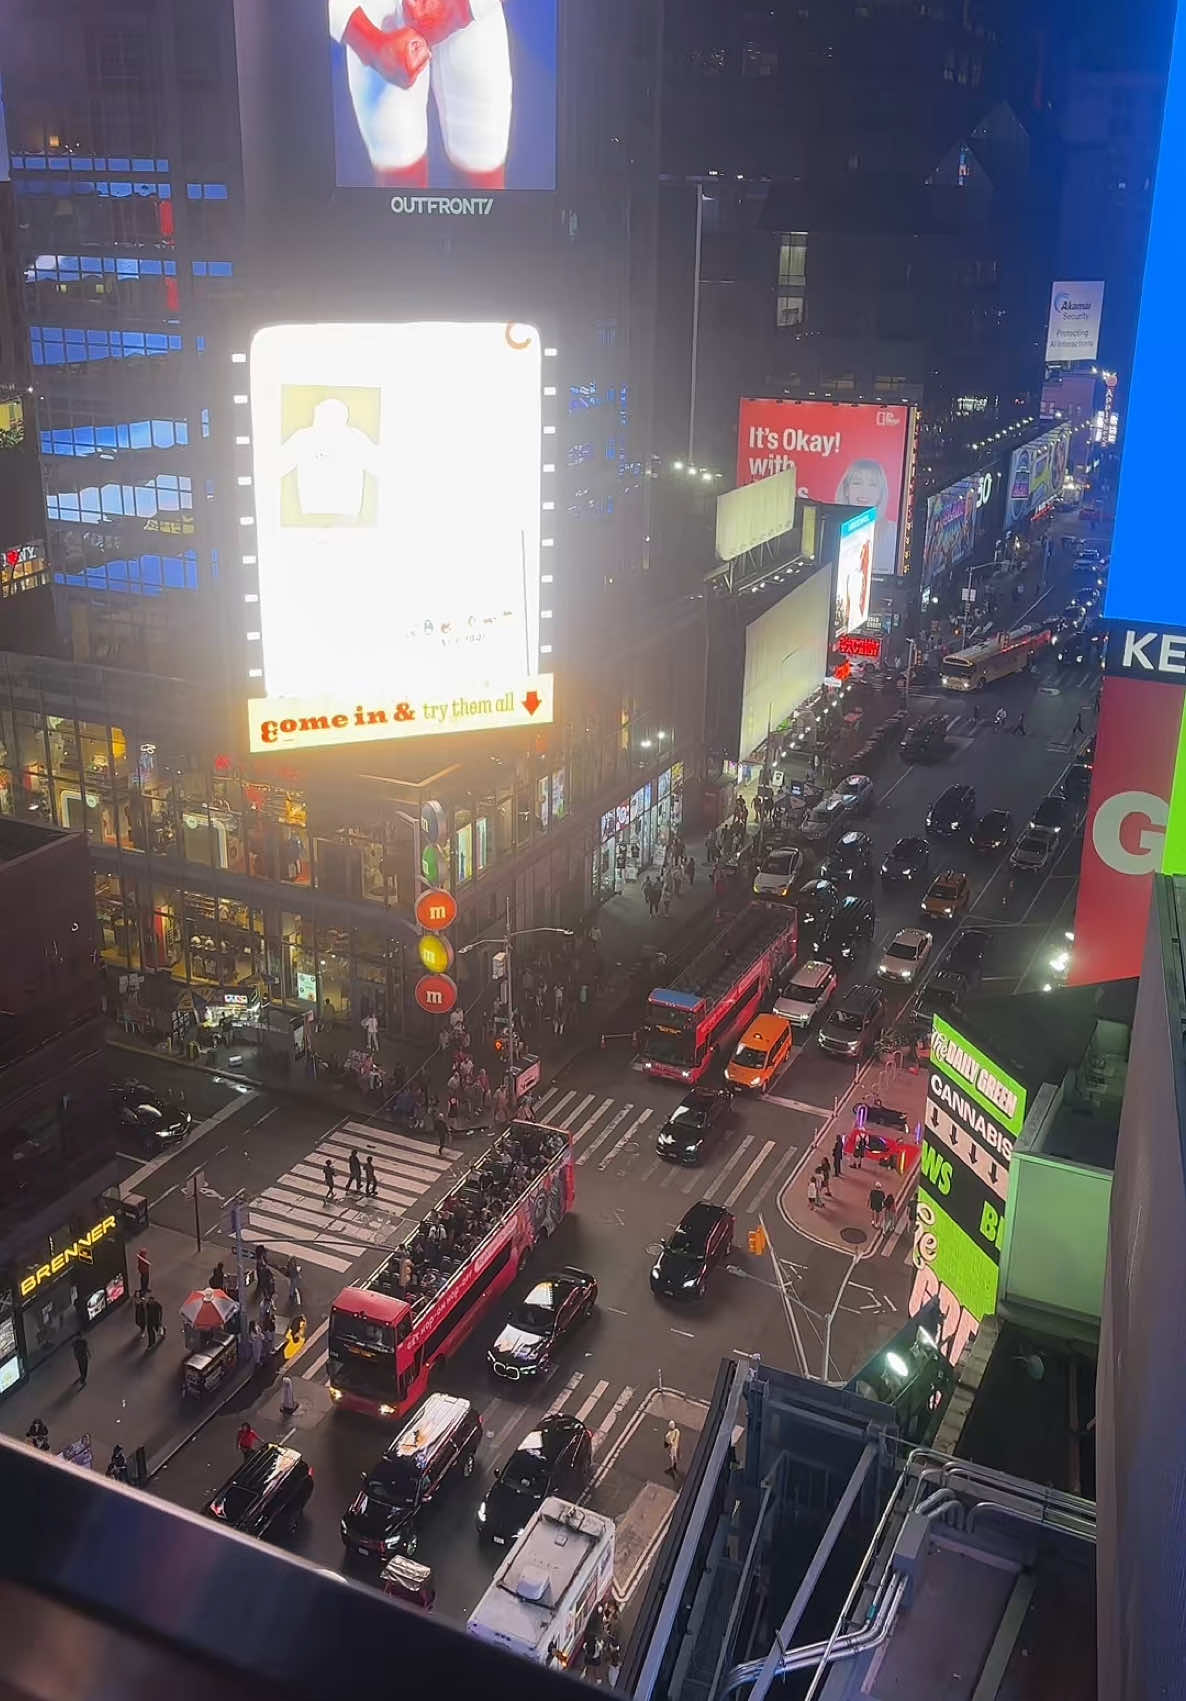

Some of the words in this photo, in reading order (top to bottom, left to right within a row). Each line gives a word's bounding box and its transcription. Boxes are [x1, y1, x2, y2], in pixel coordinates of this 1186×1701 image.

[750, 426, 779, 450] It's
[783, 428, 842, 457] Okay!
[749, 453, 796, 477] with
[354, 705, 387, 726] in
[393, 702, 415, 722] &
[423, 703, 448, 723] try
[452, 697, 492, 717] them
[495, 692, 515, 712] all
[429, 906, 446, 921] m
[426, 990, 443, 1005] m
[930, 1074, 1013, 1162] CANNABIS
[20, 1215, 117, 1297] BRENNER
